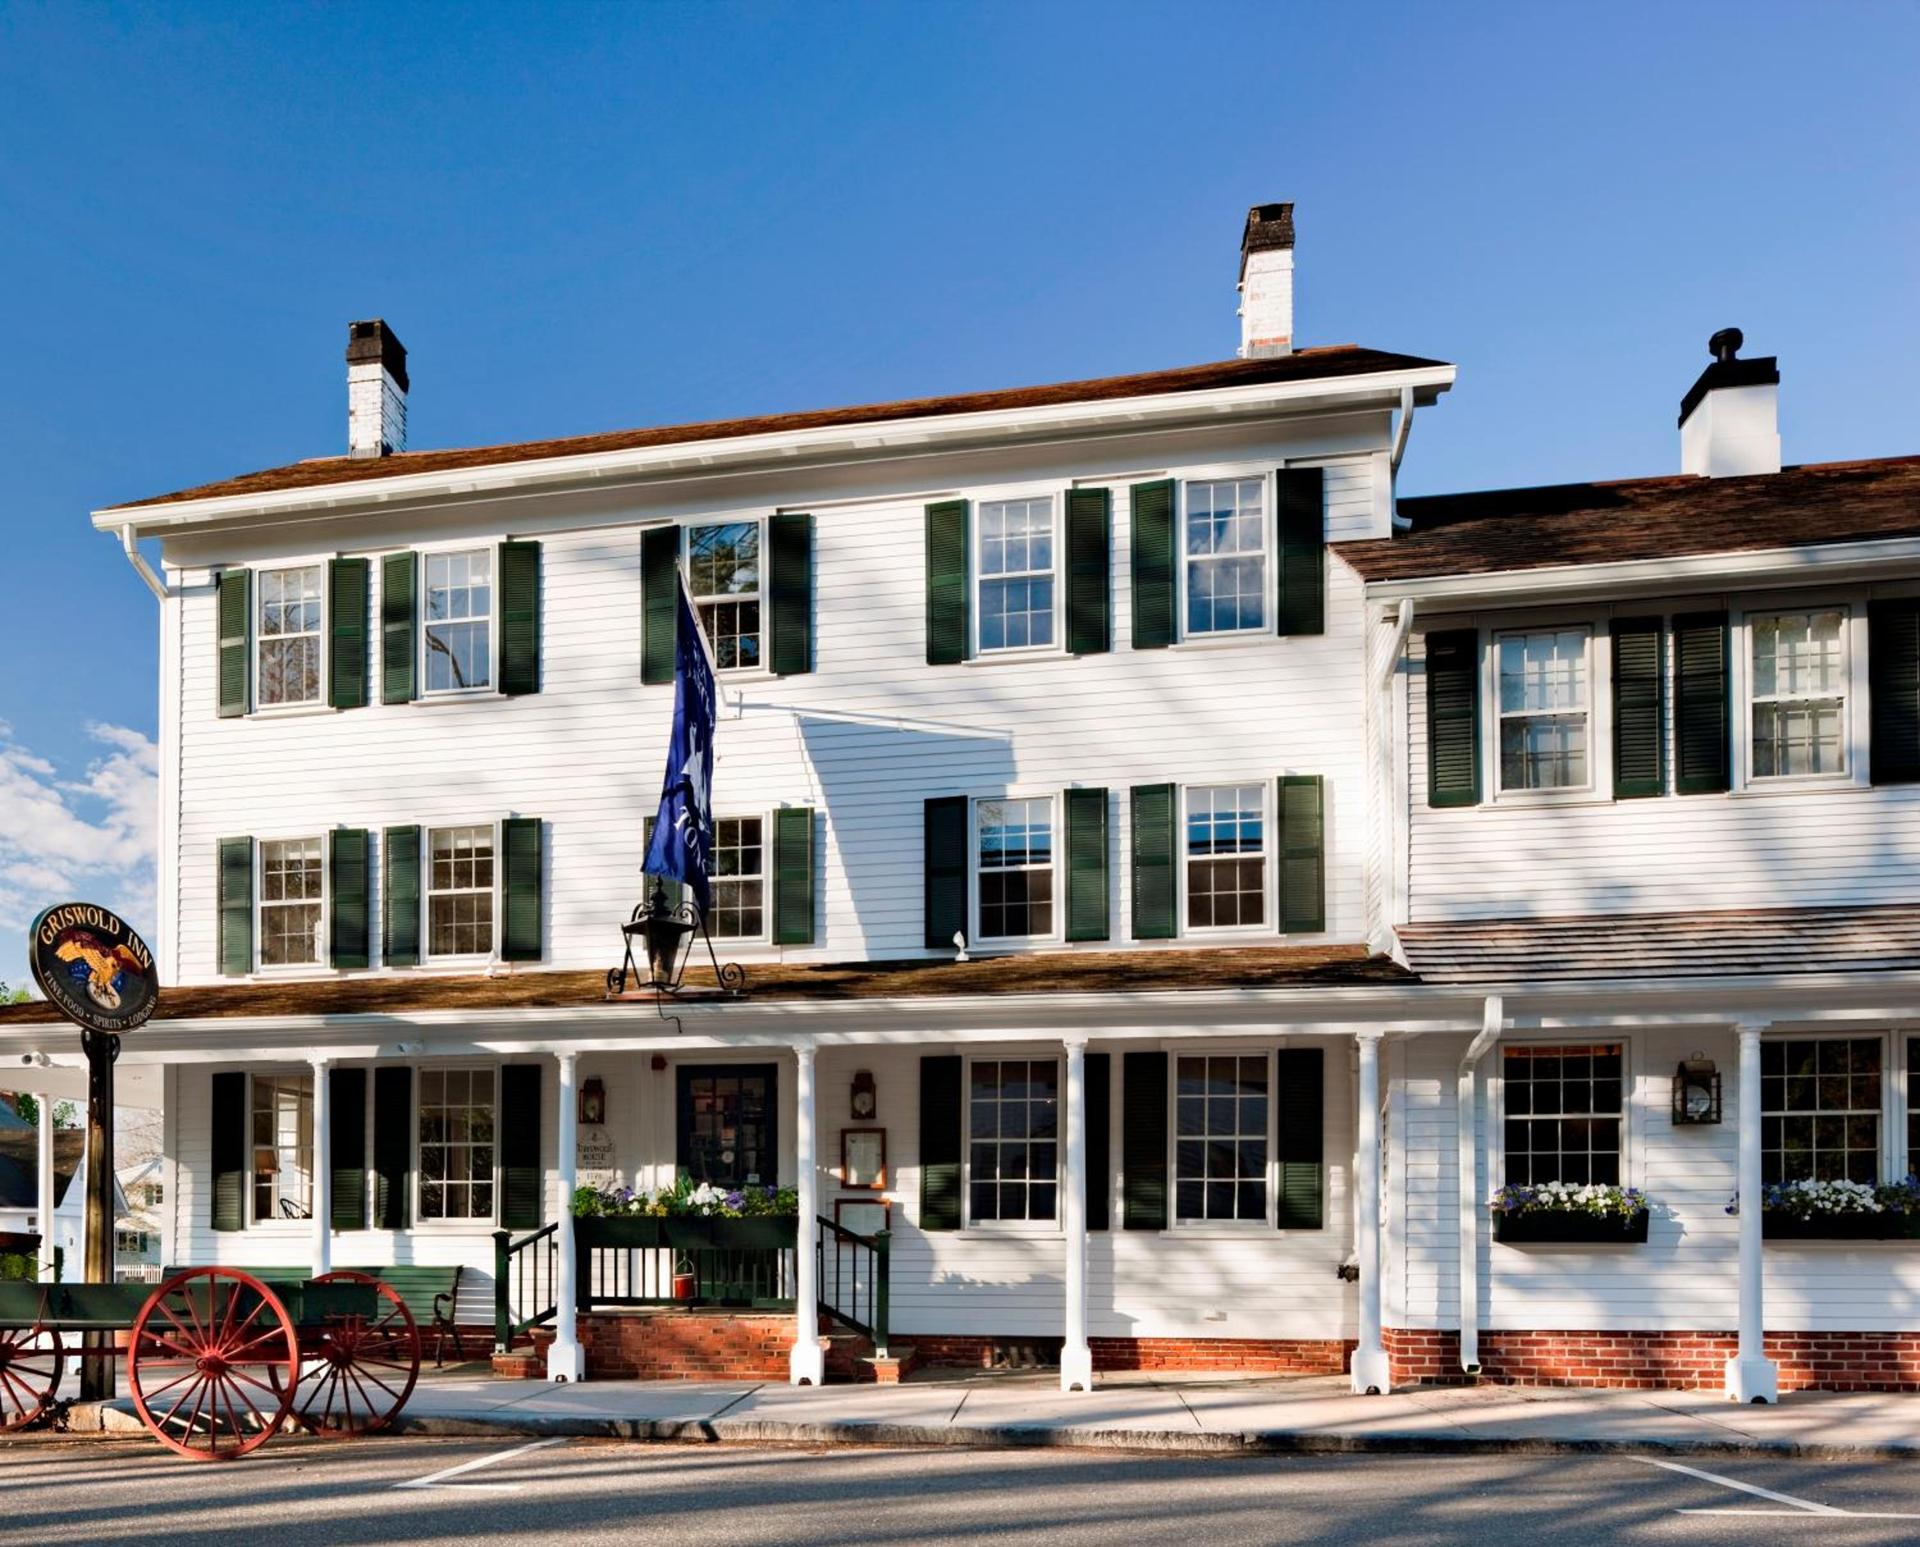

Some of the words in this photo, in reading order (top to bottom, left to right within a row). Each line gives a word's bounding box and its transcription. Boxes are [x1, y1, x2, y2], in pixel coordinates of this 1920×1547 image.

[41, 906, 120, 945] GRISWOLD
[127, 932, 152, 969] INN
[45, 971, 62, 996] FINE
[63, 995, 84, 1016] FOOD
[93, 1015, 122, 1029] SPIRITS
